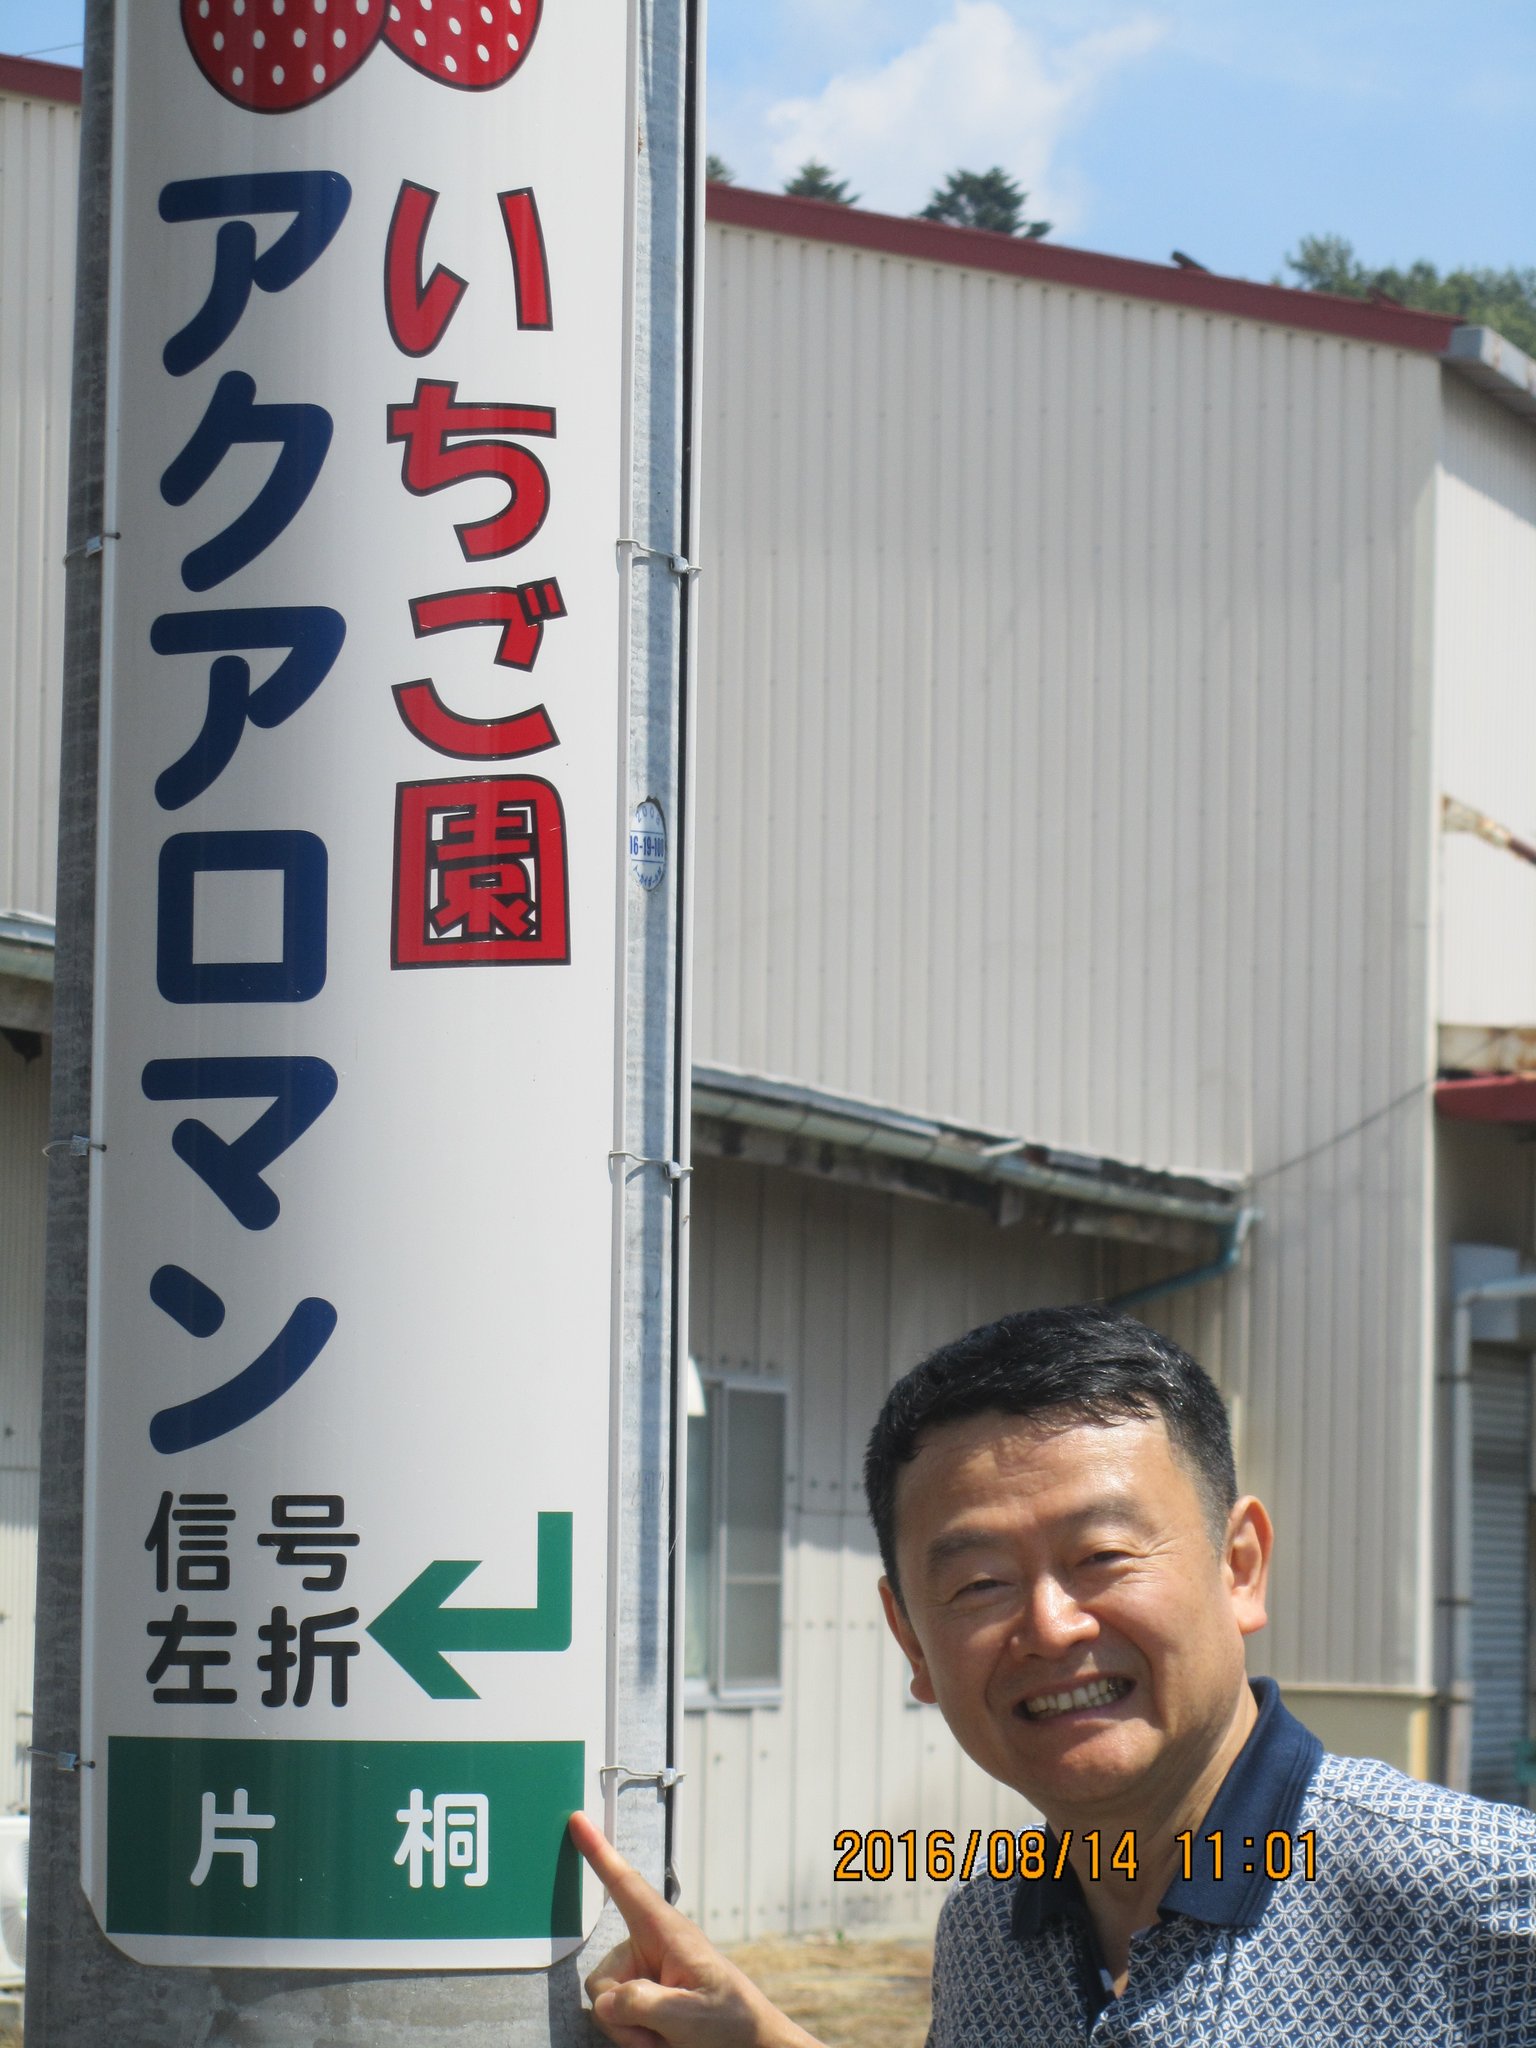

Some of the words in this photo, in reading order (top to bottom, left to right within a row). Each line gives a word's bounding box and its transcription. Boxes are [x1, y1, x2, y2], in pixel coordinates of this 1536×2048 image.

[384, 179, 571, 970] いちご園
[141, 171, 352, 1456] アクアロマン
[144, 1491, 360, 1593] 信号
[146, 1604, 360, 1708] 左折
